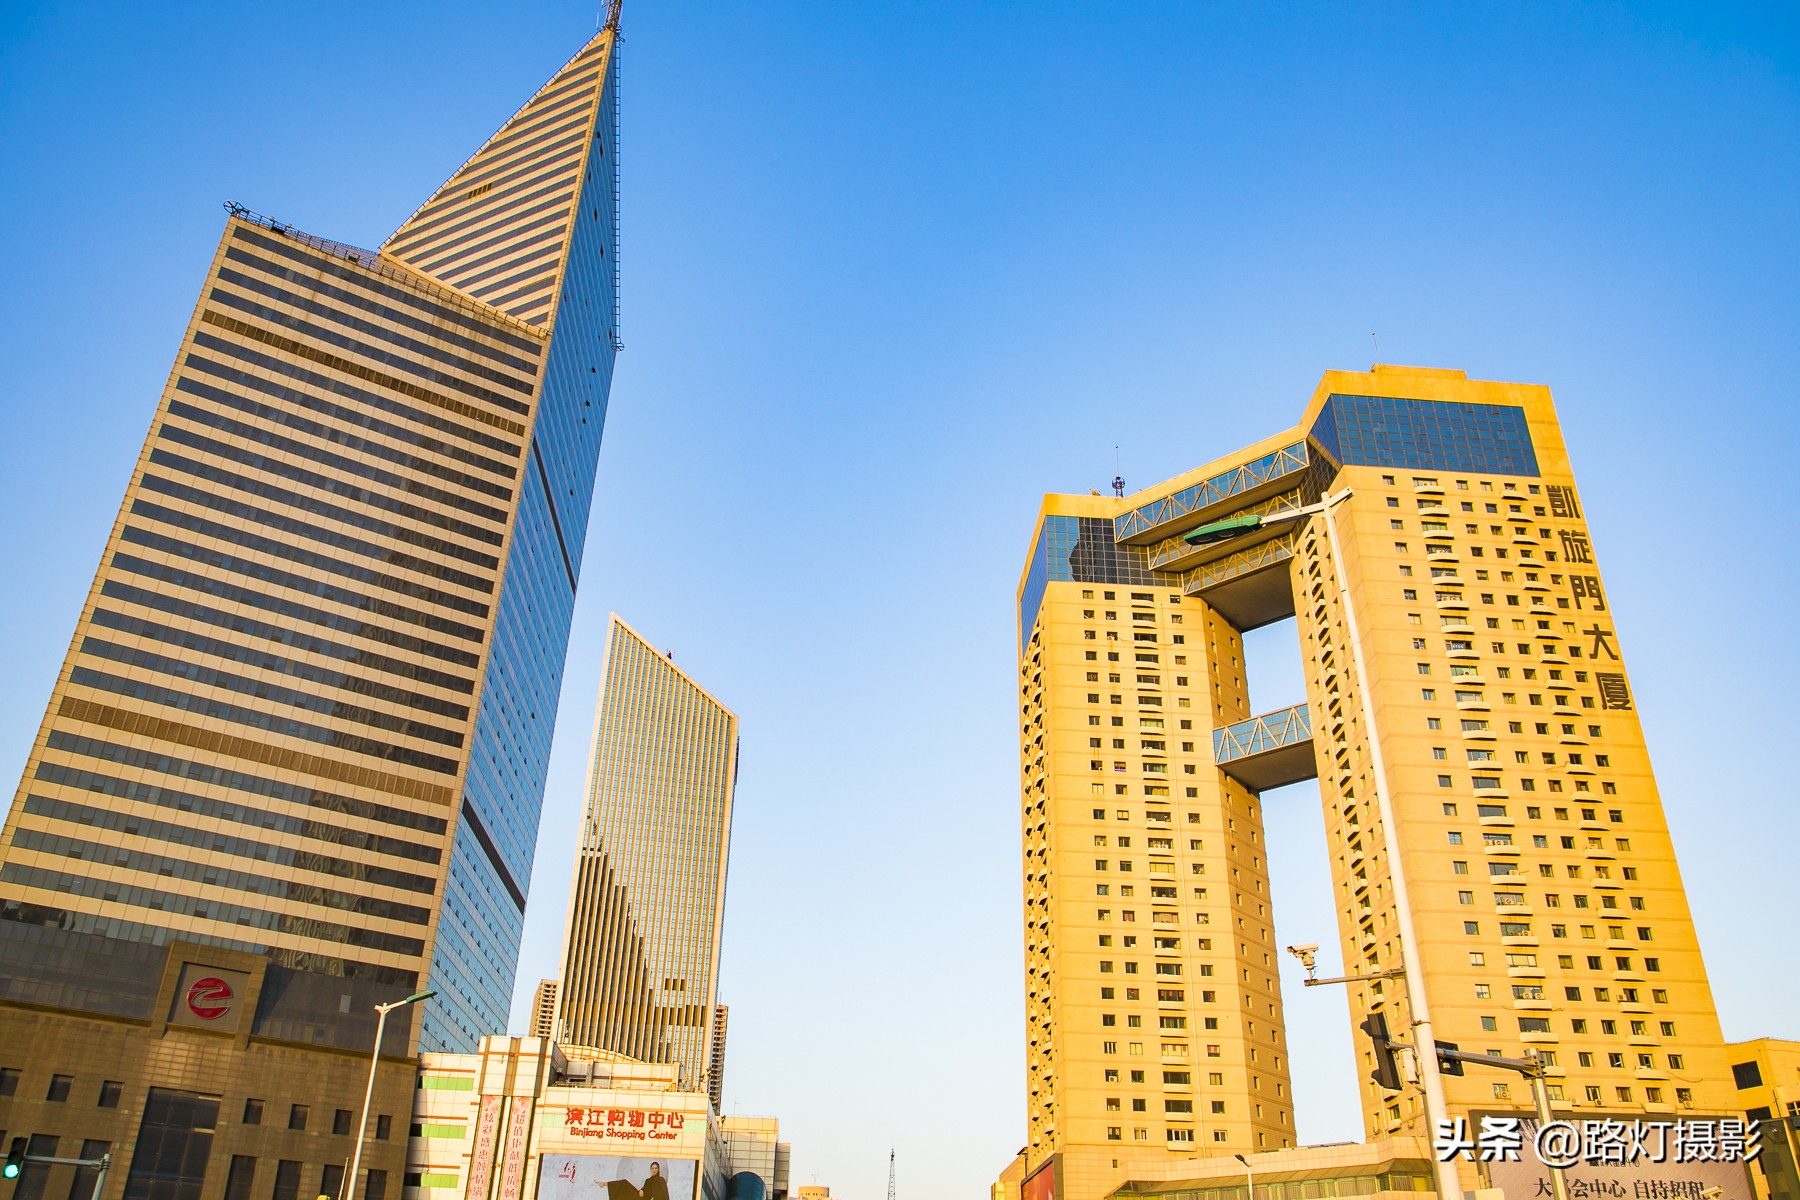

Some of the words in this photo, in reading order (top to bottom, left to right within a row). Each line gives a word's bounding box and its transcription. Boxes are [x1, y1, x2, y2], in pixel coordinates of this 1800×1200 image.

[564, 1107, 685, 1129] 滨江购物中心
[570, 1126, 604, 1139] Binjiang
[606, 1128, 646, 1140] Shopping
[648, 1130, 677, 1140] Center
[1534, 1178, 1627, 1199] 大会中心
